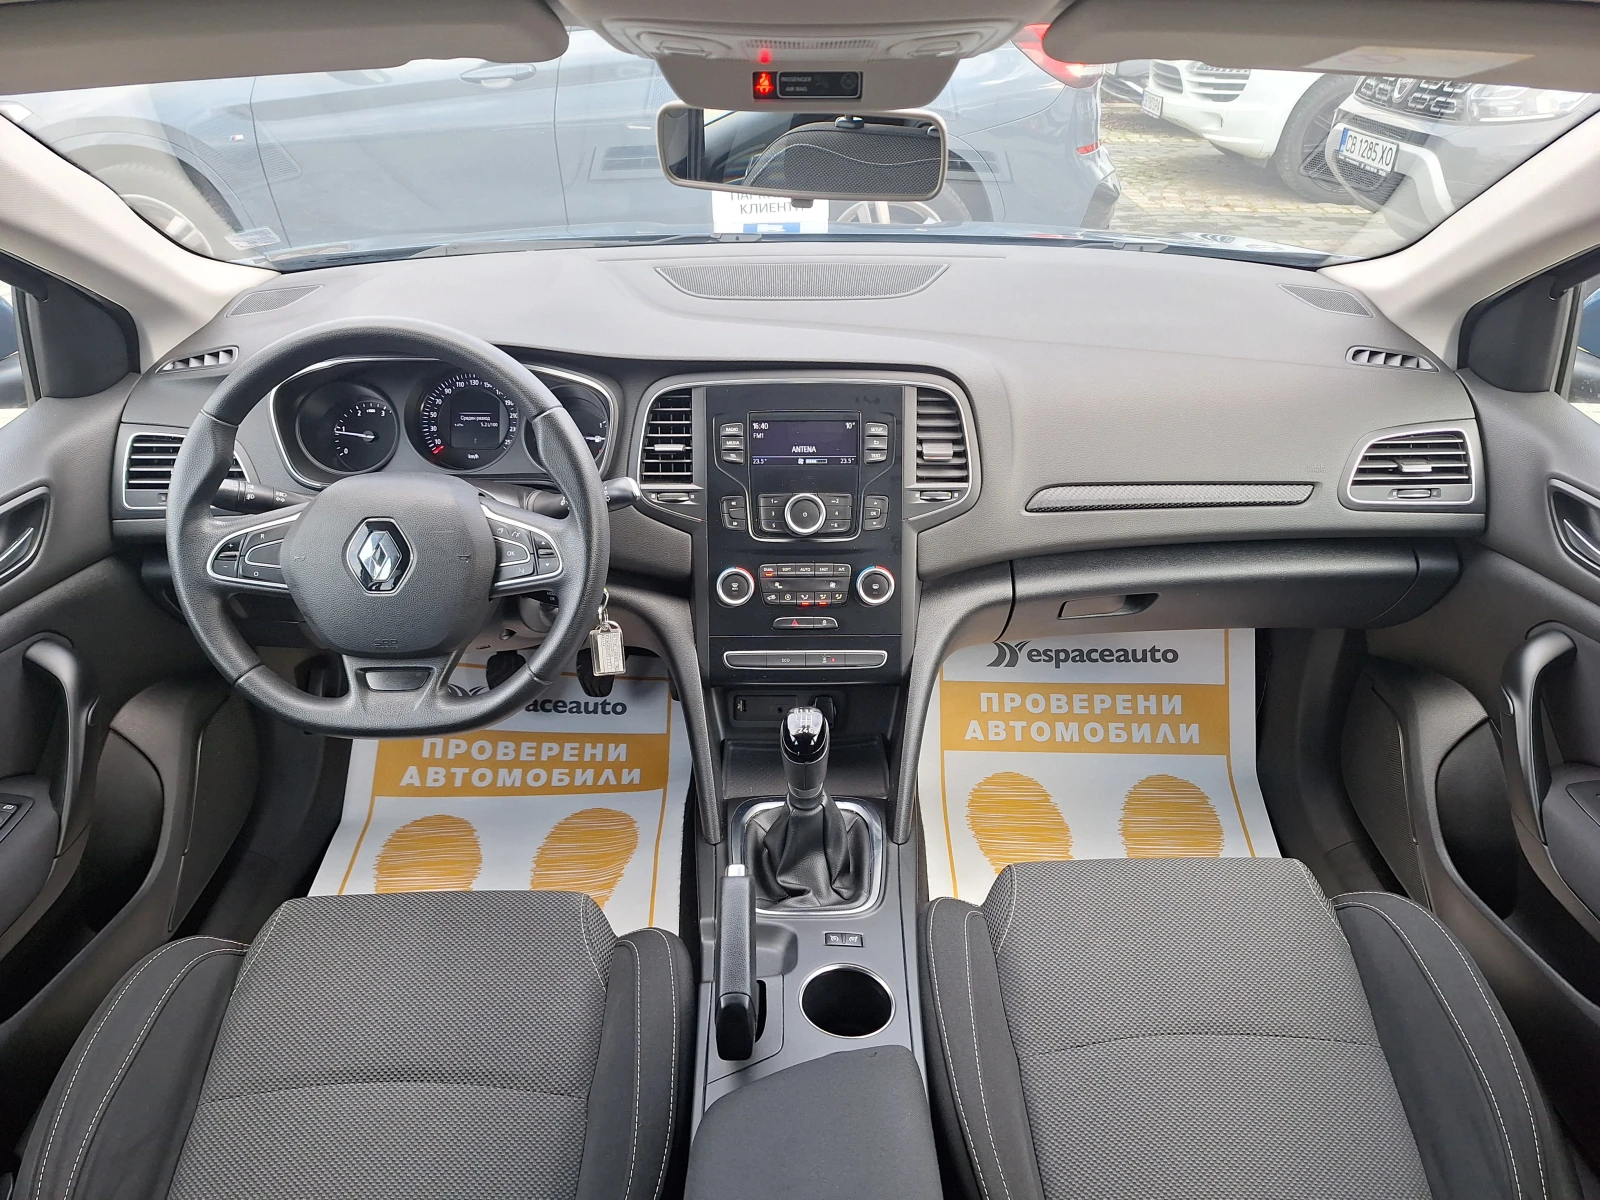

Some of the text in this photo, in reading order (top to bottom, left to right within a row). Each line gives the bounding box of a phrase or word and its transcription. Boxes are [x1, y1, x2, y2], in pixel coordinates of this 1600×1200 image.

[1357, 137, 1380, 162] 1285
[740, 201, 804, 215] КЛИЕНТ
[752, 422, 769, 430] 16:40
[791, 445, 817, 453] ANTENA
[1026, 644, 1179, 669] espaceauto
[524, 698, 628, 716] aceauto
[980, 692, 1183, 715] ПРОВЕРЕНИ
[964, 720, 1200, 745] АВТОМОБИЛИ
[421, 738, 628, 762] ПРОВЕРЕНИ
[400, 765, 641, 788] АВТОМОБИЛИ
